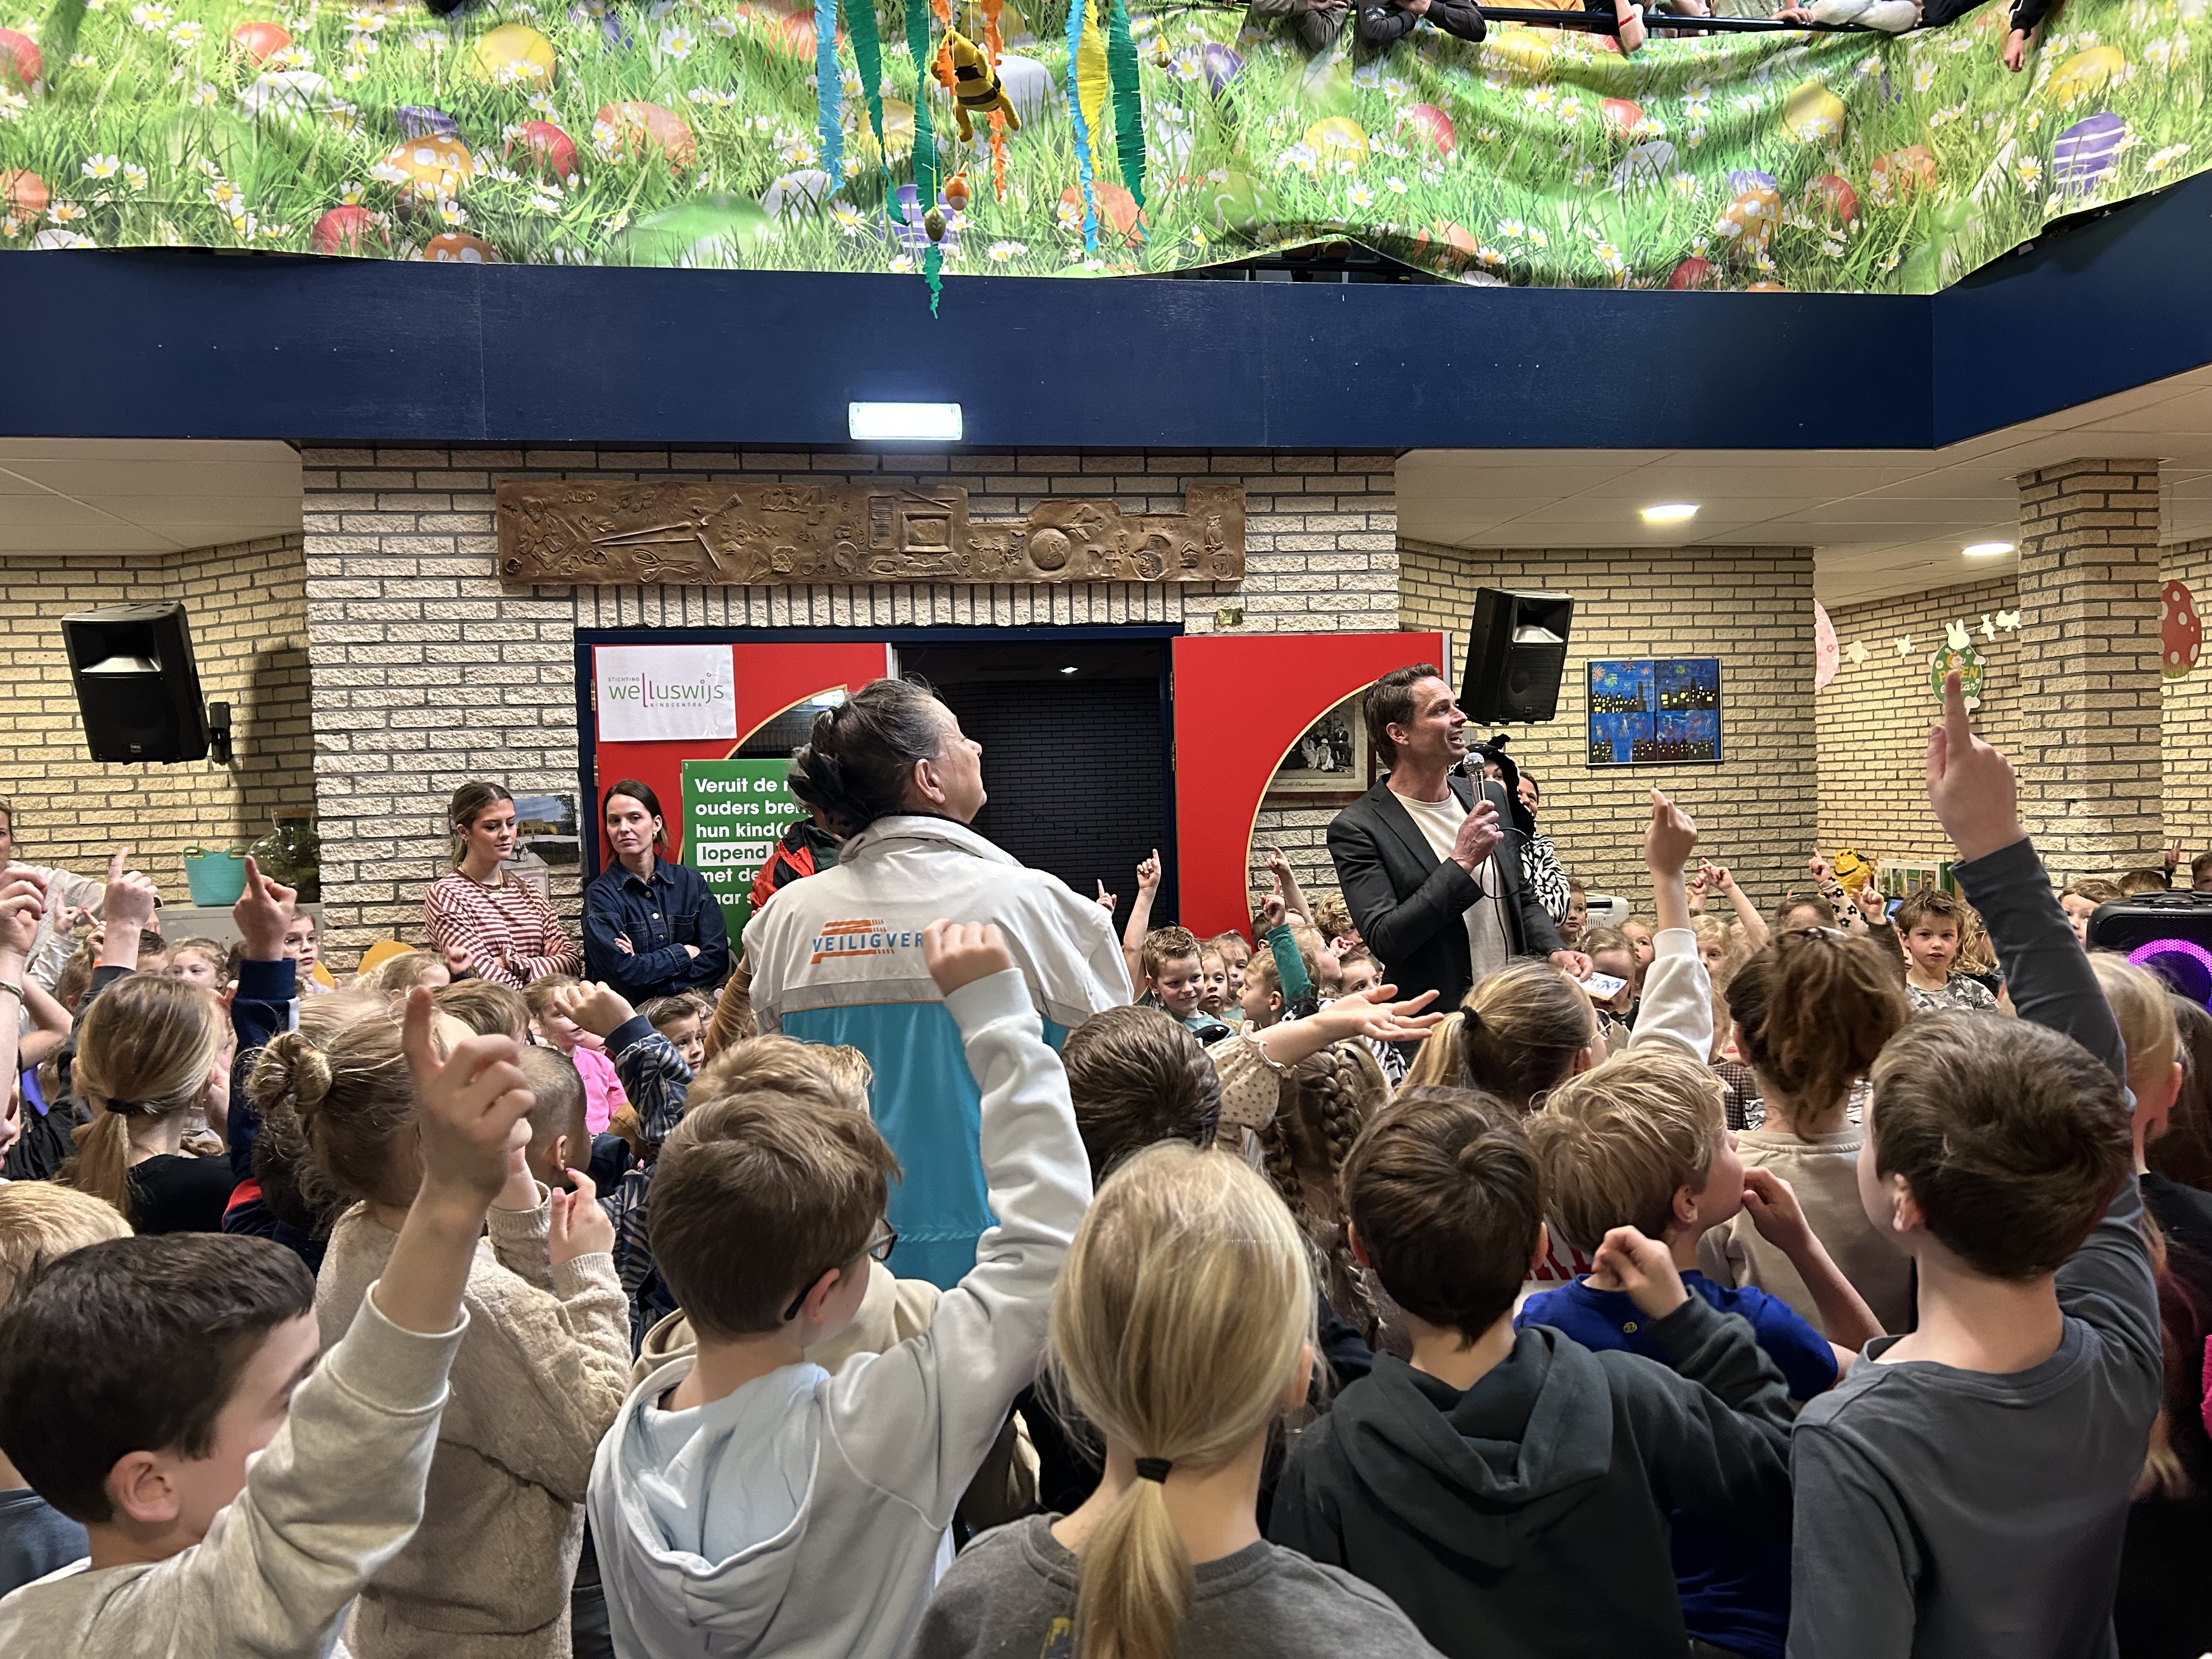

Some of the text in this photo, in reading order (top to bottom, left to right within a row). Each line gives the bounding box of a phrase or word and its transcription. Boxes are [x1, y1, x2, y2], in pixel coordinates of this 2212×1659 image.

[1938, 667, 1978, 682] PEN
[608, 673, 724, 708] welluswijs
[695, 778, 748, 793] Veruit
[753, 777, 778, 792] de
[695, 800, 808, 815] ouders bre
[696, 823, 730, 838] hun
[702, 845, 767, 862] lopend
[812, 933, 924, 952] VEILIGVER
